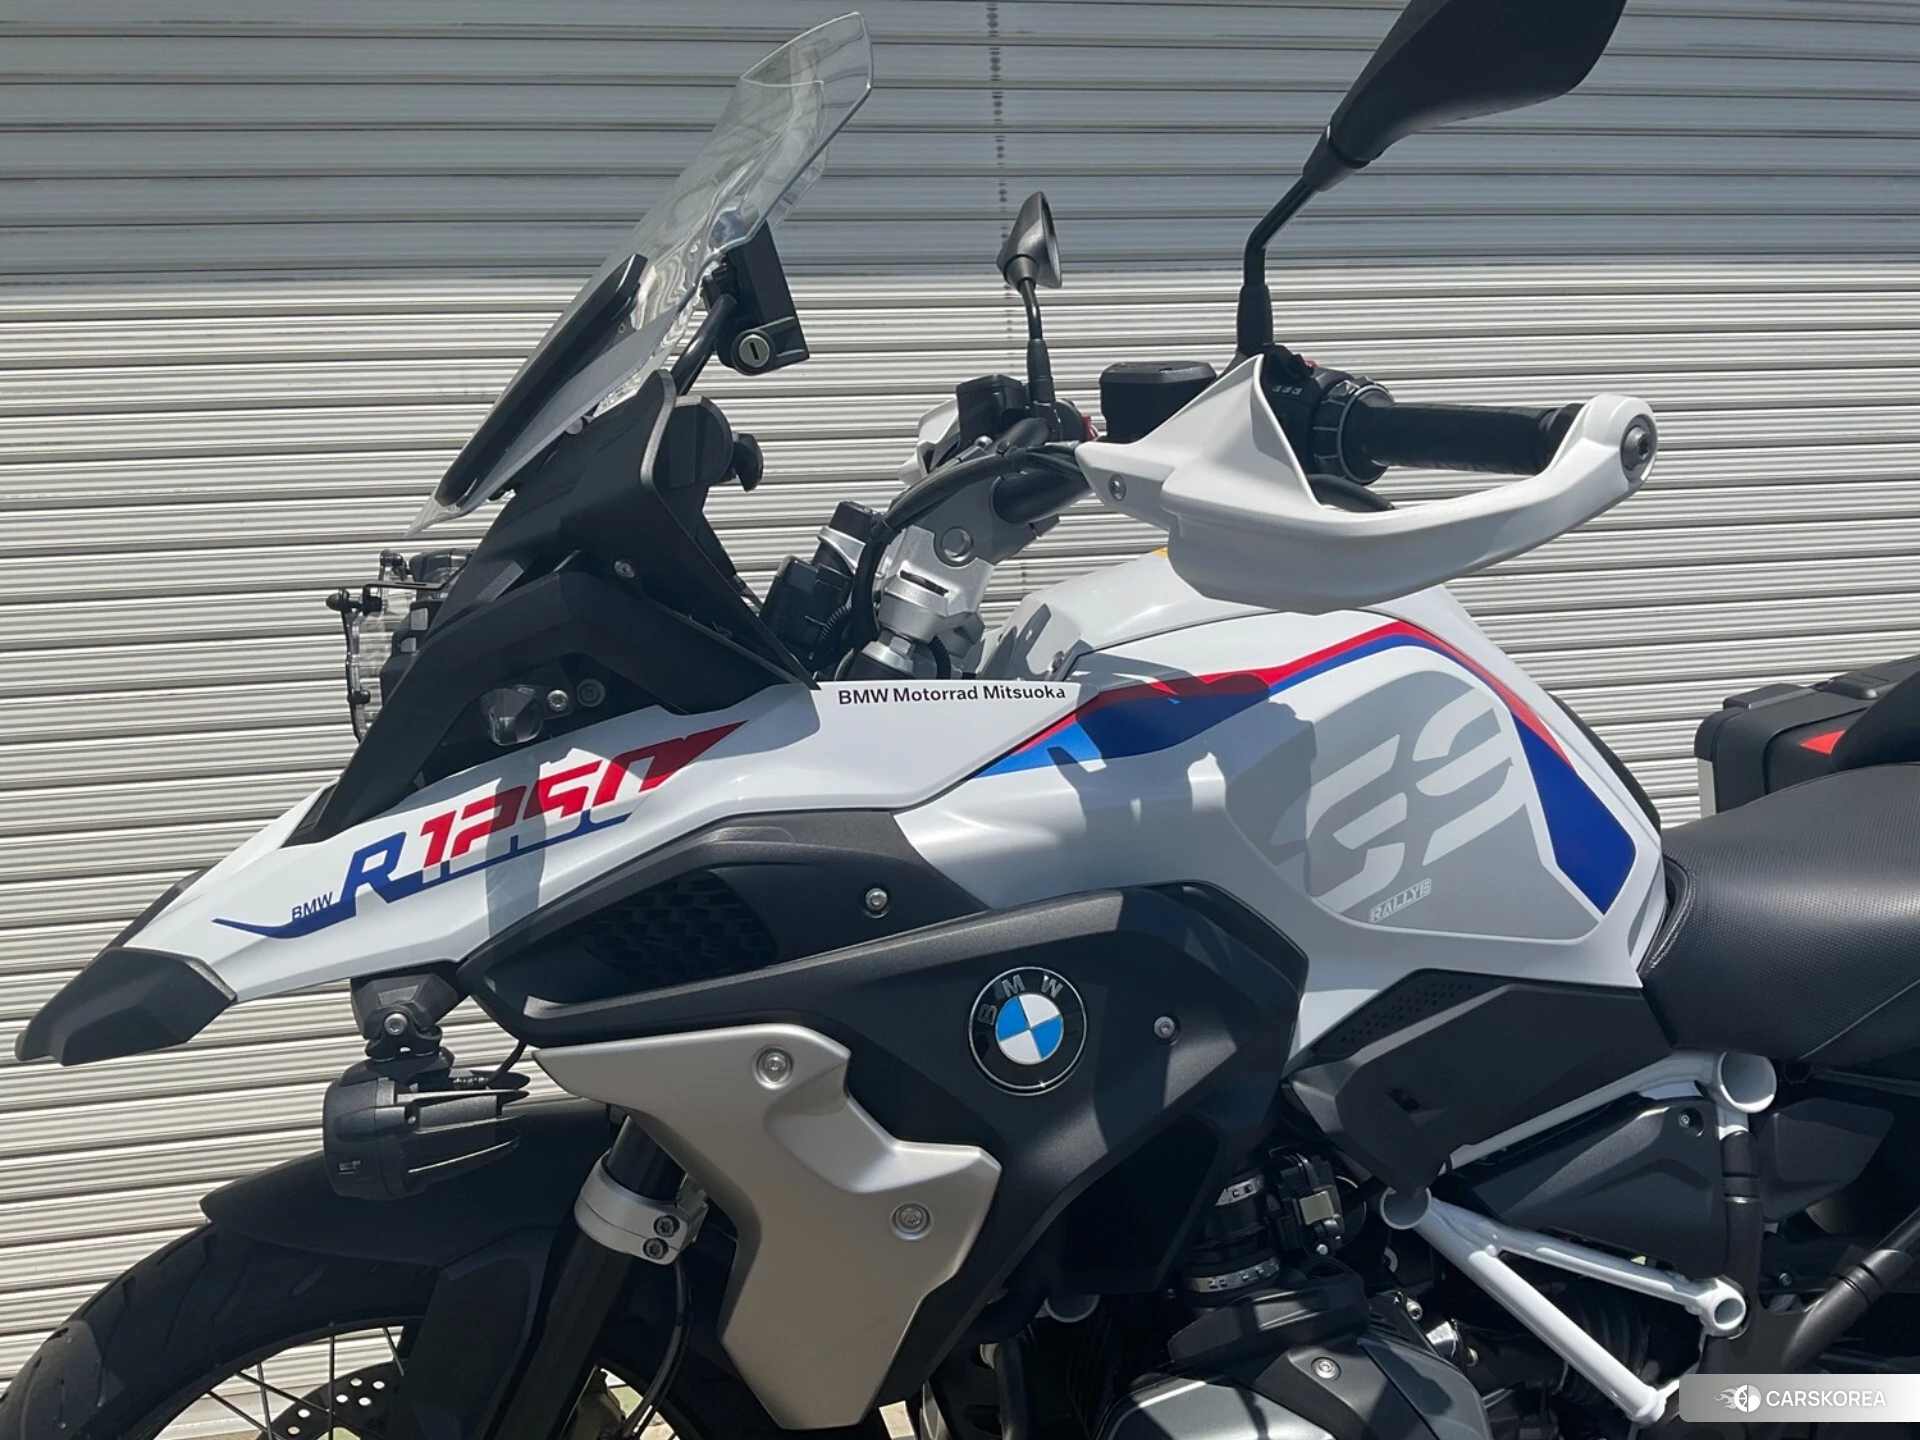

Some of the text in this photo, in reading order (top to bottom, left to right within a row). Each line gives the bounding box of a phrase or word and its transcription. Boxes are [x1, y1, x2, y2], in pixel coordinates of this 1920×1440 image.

[838, 684, 1066, 704] BMW Motorrad Mitsuoka
[291, 891, 333, 921] BMW
[419, 720, 748, 869] 1250
[1370, 879, 1432, 924] RALLYE
[976, 973, 1064, 1026] BMW
